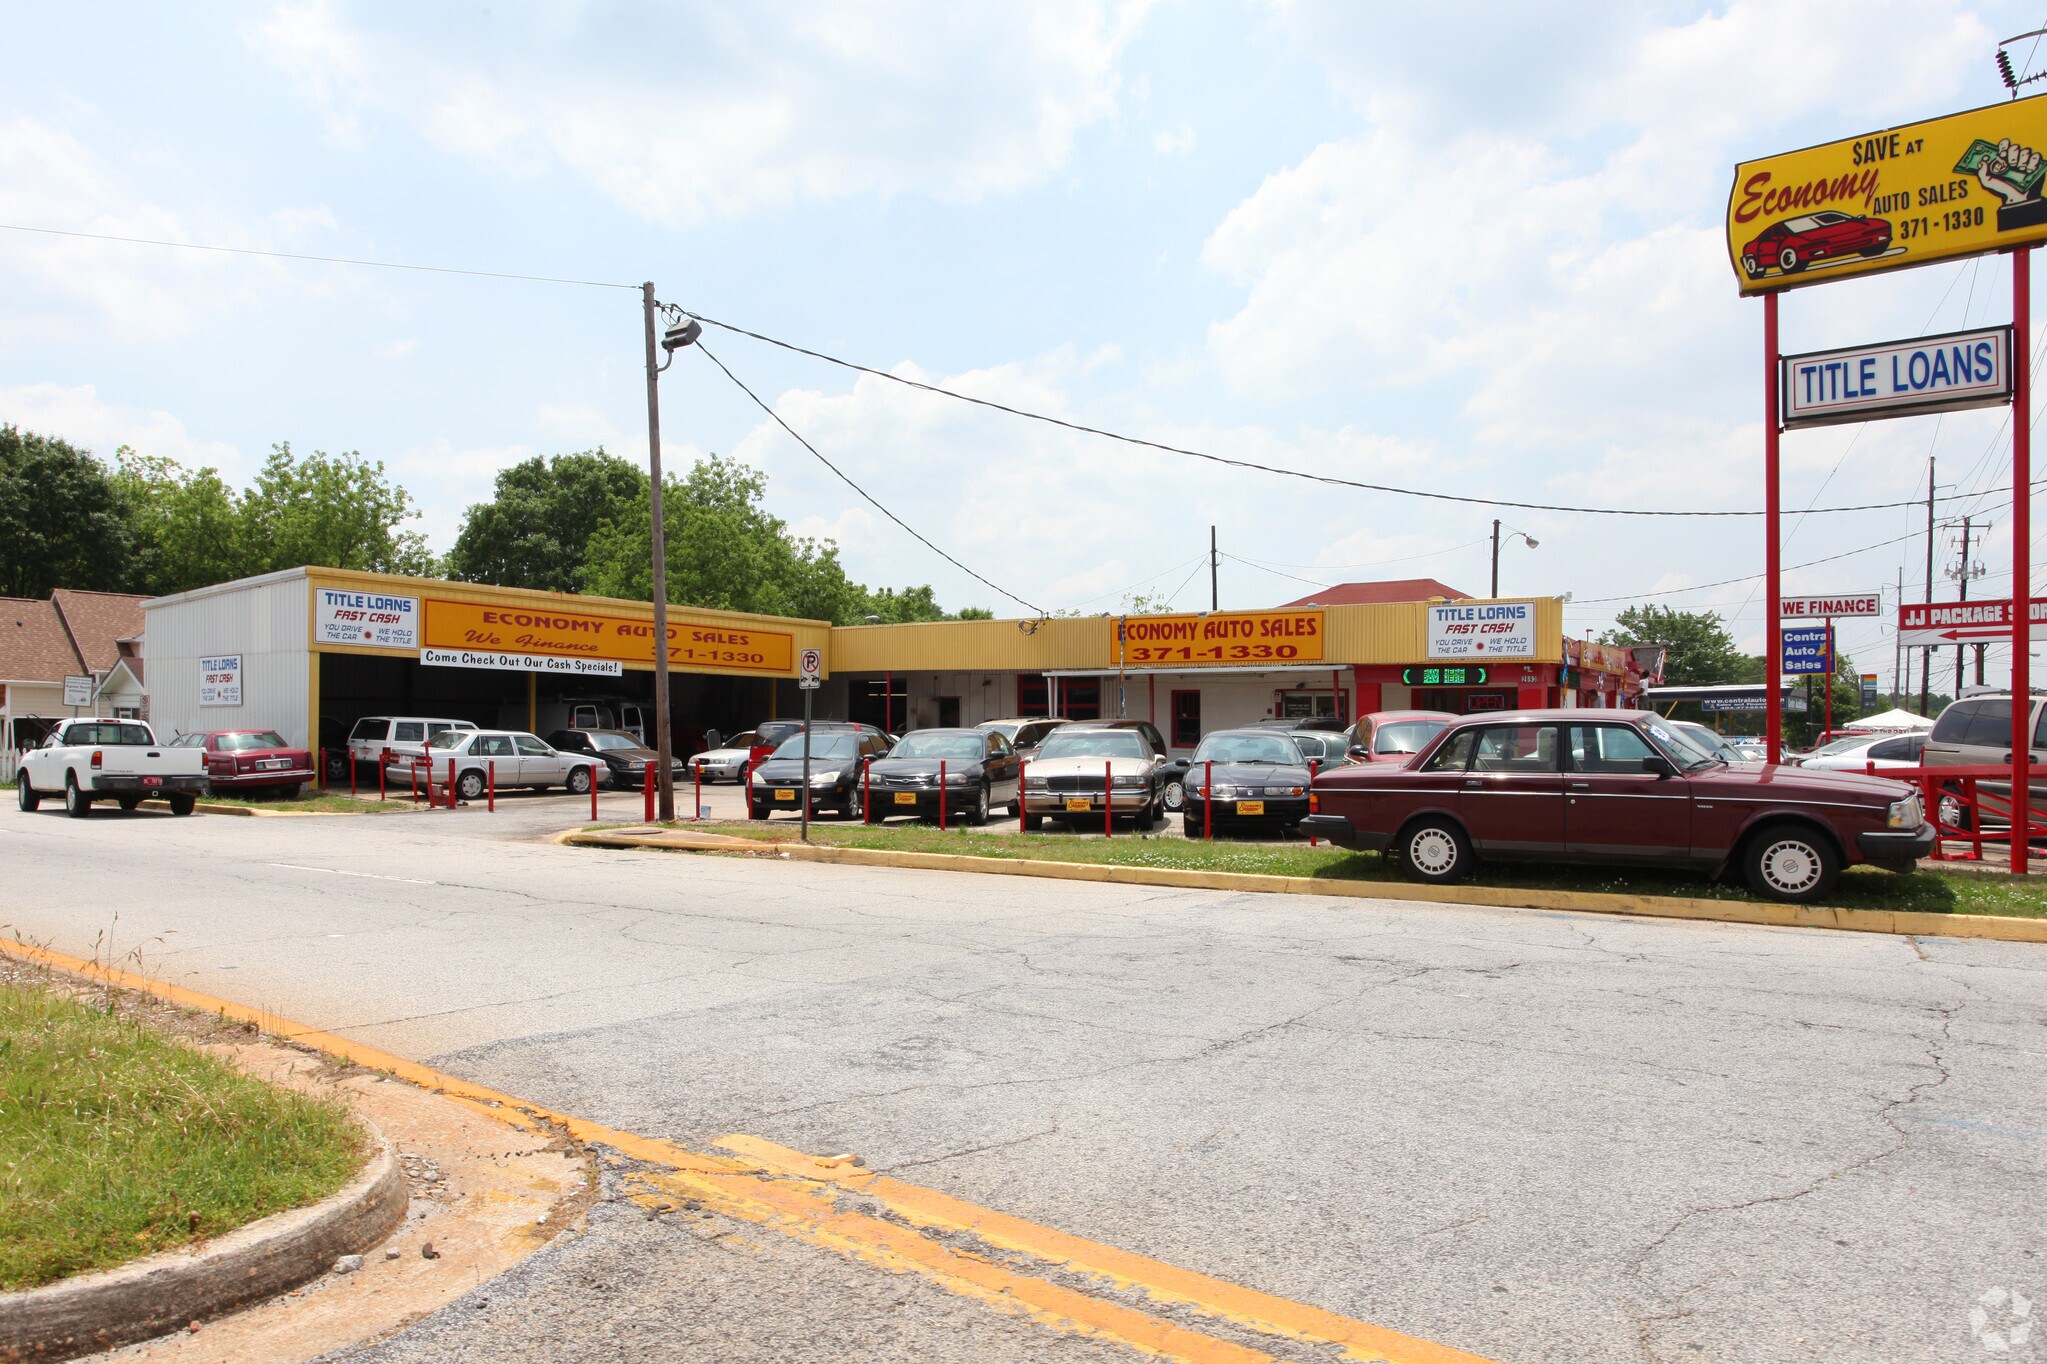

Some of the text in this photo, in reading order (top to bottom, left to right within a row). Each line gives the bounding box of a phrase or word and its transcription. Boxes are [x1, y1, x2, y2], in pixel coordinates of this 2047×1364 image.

[1905, 139, 1924, 155] AT
[1735, 168, 1880, 224] Economy
[1873, 179, 1968, 216] AUTO SALES
[1801, 342, 1993, 403] TITLE LOANS
[325, 592, 412, 613] TITLE LOANS
[1782, 599, 1876, 614] WE FINANCE
[1436, 606, 1526, 621] TITLE LOANS
[1905, 610, 1925, 626] JJ
[1930, 605, 2003, 625] PACKAGE
[325, 623, 363, 633] YOU DRIVE
[378, 627, 413, 637] WE HOLD
[483, 611, 604, 634] ECONOMY
[692, 631, 749, 646] SALES
[1118, 617, 1317, 641] ECONOMY AUTO SALES
[326, 631, 358, 641] THE CAR
[376, 635, 412, 645] THE TITLE
[464, 629, 600, 652] We Finance
[1451, 638, 1474, 646] DRIVE
[1489, 637, 1527, 645] WE HOLD
[1132, 644, 1298, 661] 371-1330
[1452, 646, 1468, 654] CAR
[1506, 645, 1528, 653] TITLE
[1785, 646, 1816, 657] Auto
[202, 658, 238, 671] TITLE LOANS
[425, 650, 618, 673] Come Check Out Our Cash Specials!
[1785, 660, 1822, 670] Sales
[1470, 696, 1504, 709] OPEN
